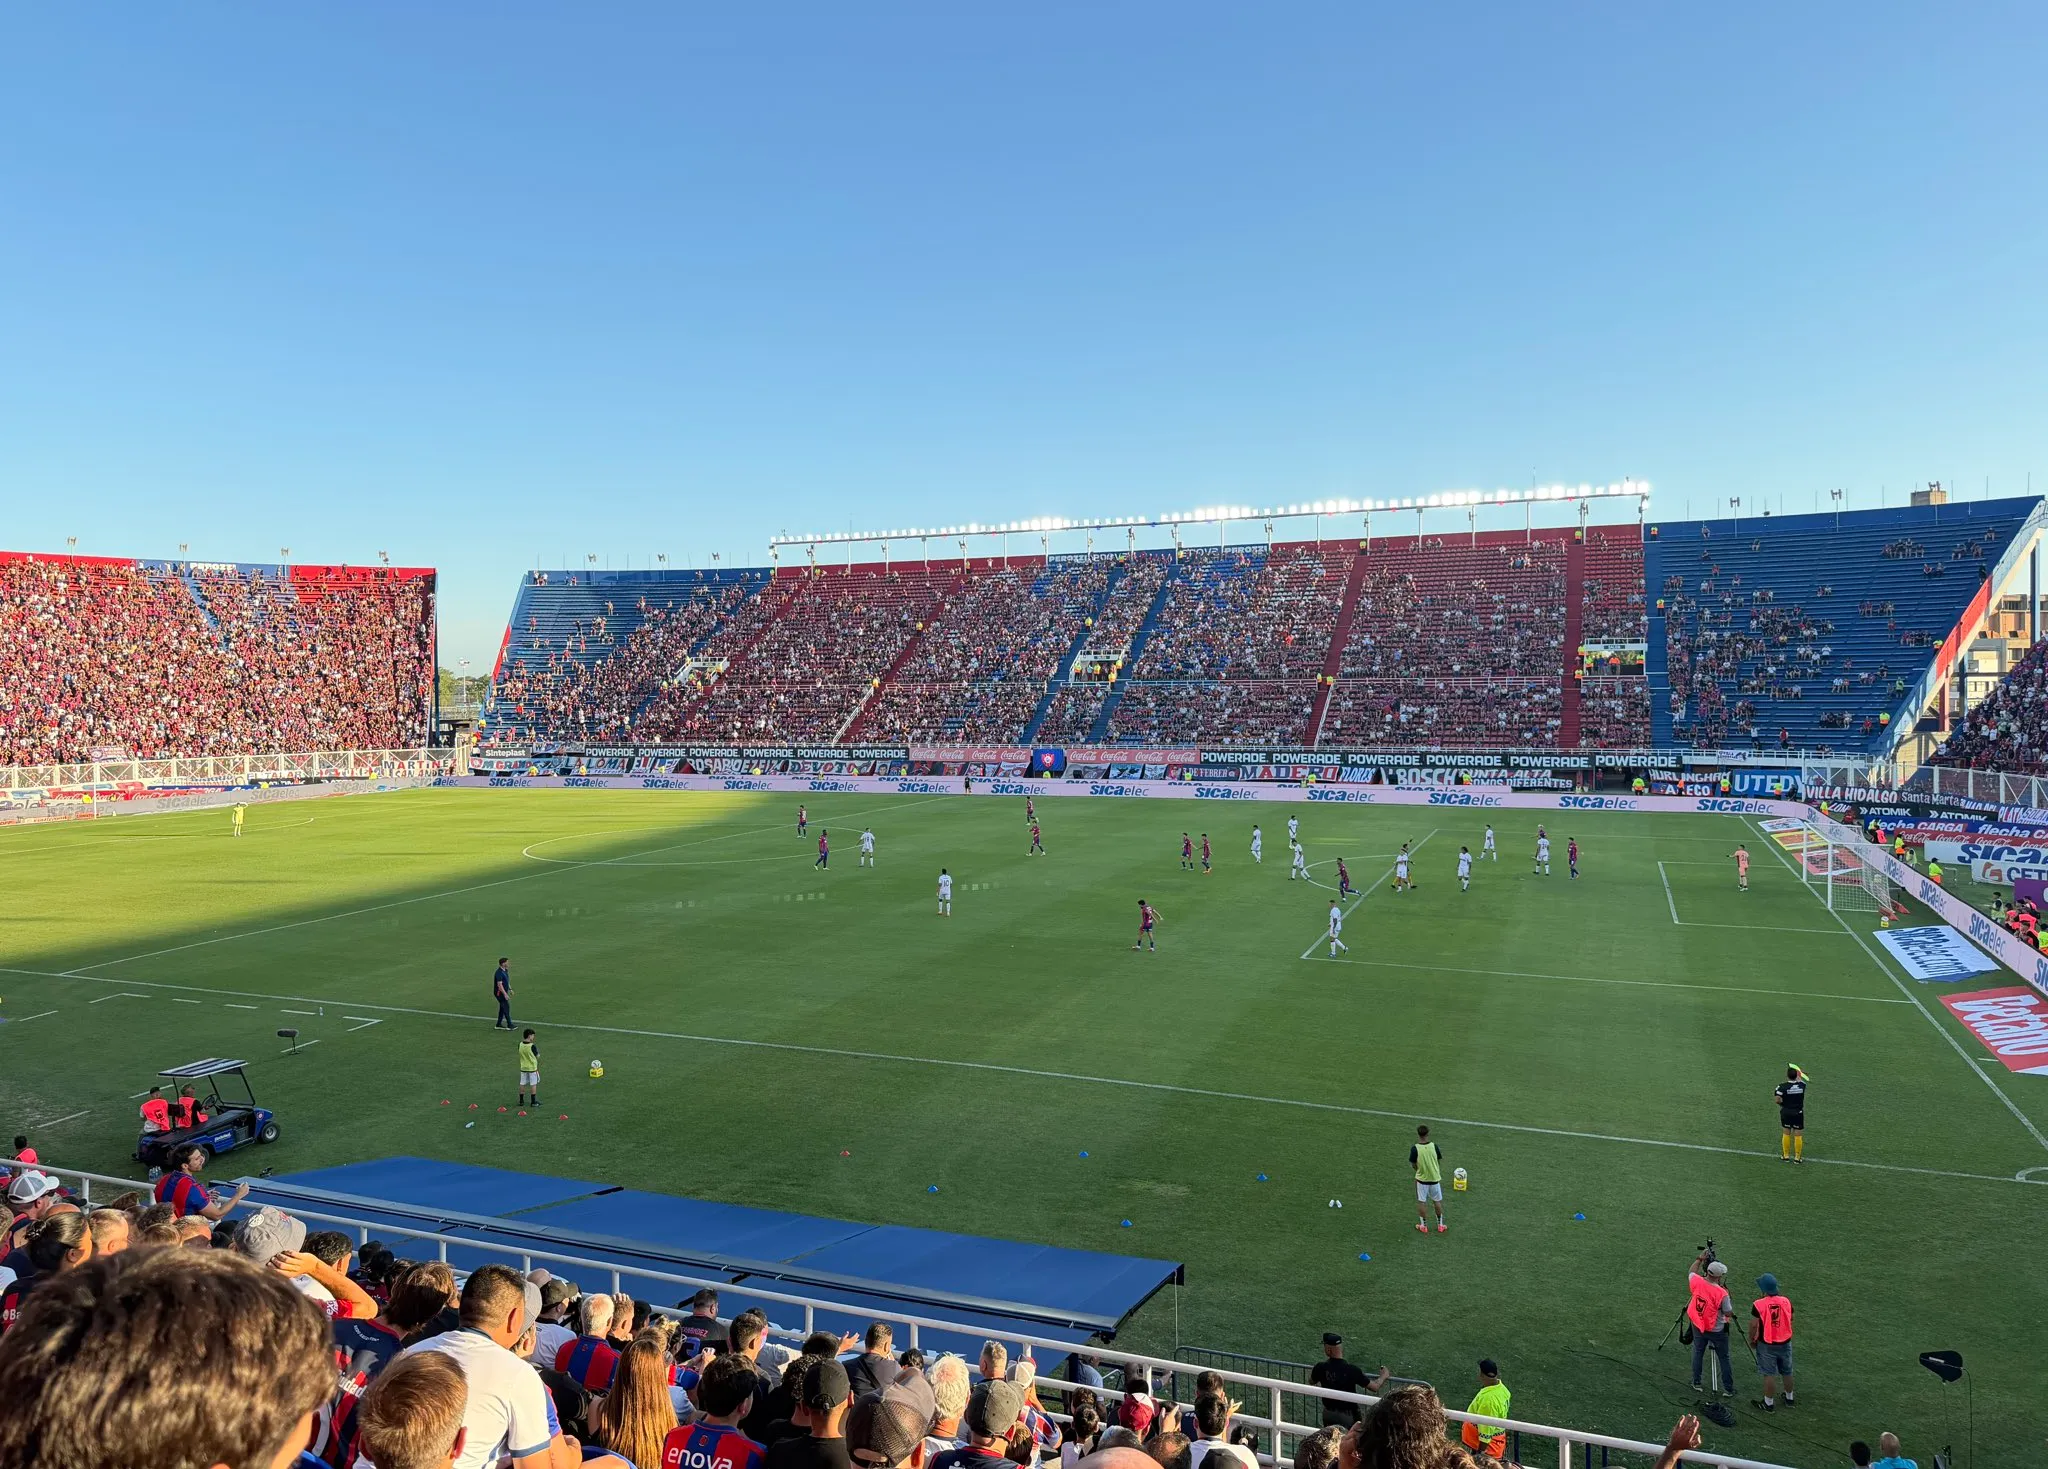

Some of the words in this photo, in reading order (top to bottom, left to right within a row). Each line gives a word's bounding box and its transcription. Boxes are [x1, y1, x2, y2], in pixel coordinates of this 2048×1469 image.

[485, 748, 526, 758] Sinteplast
[383, 758, 458, 770] MARTINEZ
[586, 757, 627, 769] LOMA
[789, 761, 857, 774] DEVOTO
[1240, 765, 1338, 781] MADERO
[1340, 767, 1376, 783] FLORES
[1510, 769, 1551, 779] ALTA
[642, 778, 689, 789] sicaelec
[724, 780, 772, 790] sicaelec
[808, 781, 859, 792] sicaelec
[897, 782, 951, 793] sicaelec
[991, 783, 1047, 795] sicaelec
[1506, 778, 1573, 789] DIFERENTES
[1089, 784, 1150, 796] sicaelec
[1194, 787, 1259, 799] sicaelec
[1307, 789, 1375, 802] sicaelec
[1806, 785, 1842, 800] VILLA
[1844, 787, 1898, 804] HIDALGO
[1428, 792, 1503, 806] sicaelec
[1558, 795, 1638, 810] sicaelec
[1901, 791, 1931, 804] Santa
[1696, 799, 1774, 814] sicaelec
[1868, 807, 1912, 817] ATOMIK
[1916, 821, 1964, 833] CARGA
[1977, 823, 2031, 838] flecha
[667, 1446, 734, 1469] enova
